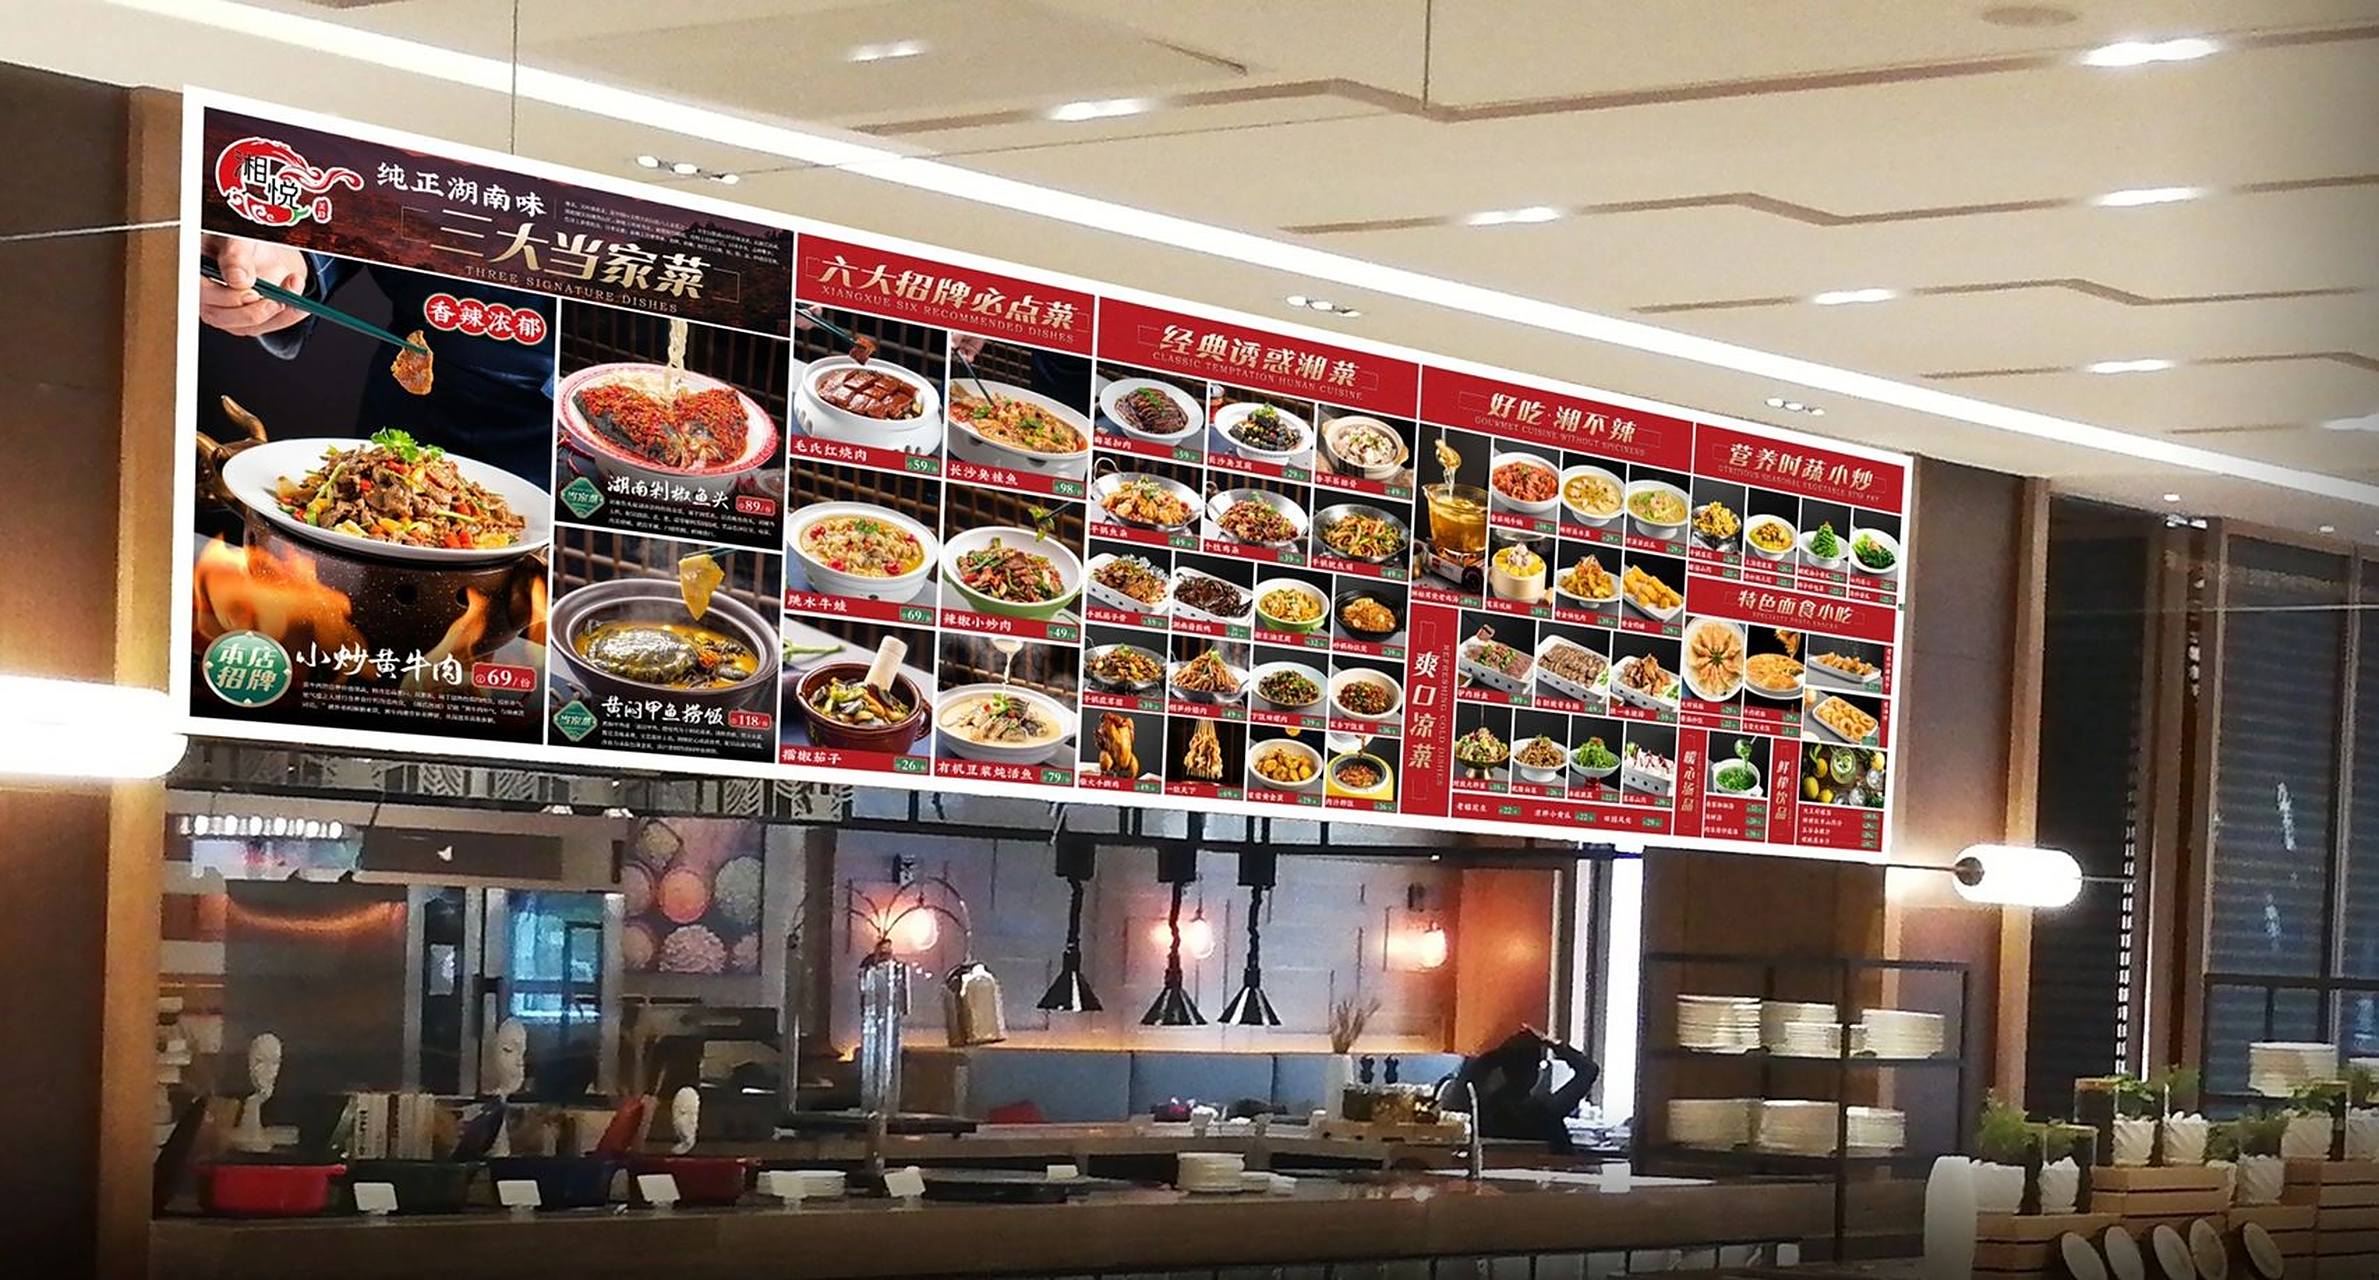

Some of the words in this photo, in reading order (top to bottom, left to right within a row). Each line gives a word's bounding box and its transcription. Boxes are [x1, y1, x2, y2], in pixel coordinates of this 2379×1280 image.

[377, 162, 547, 218] 纯正湖南味
[430, 209, 711, 299] 三大当家菜
[465, 265, 518, 284] THREE
[526, 276, 615, 301] SIGNATURE
[622, 294, 678, 313] DISHES
[819, 255, 1078, 330] 六大招牌必点菜
[429, 301, 541, 338] 香辣浓郁
[821, 285, 891, 308] XIANGXUE
[896, 300, 918, 312] SIX
[923, 305, 1024, 333] RECOMMENDED
[1028, 327, 1075, 344] DISHES
[1152, 351, 1200, 369] CLASSIC
[1205, 362, 1275, 383] TEMPTATION
[1320, 384, 1363, 400] CUISINE
[1159, 324, 1360, 386] 经典诱惑湘菜
[794, 440, 868, 462] 毛氏红烧肉
[1728, 443, 1874, 490] 营养时蔬小炒
[607, 475, 729, 509] 湖南剁椒鱼头
[943, 613, 1012, 632] 辣椒小炒肉
[1738, 590, 1854, 625] 特色面食小吃
[296, 641, 463, 686] 小炒黄牛肉
[1408, 651, 1440, 769] 爽口凉菜
[782, 749, 842, 765] 擂椒茄子
[1681, 751, 1697, 812] 暖心汤品
[1775, 760, 1790, 820] 鲜榨饮品
